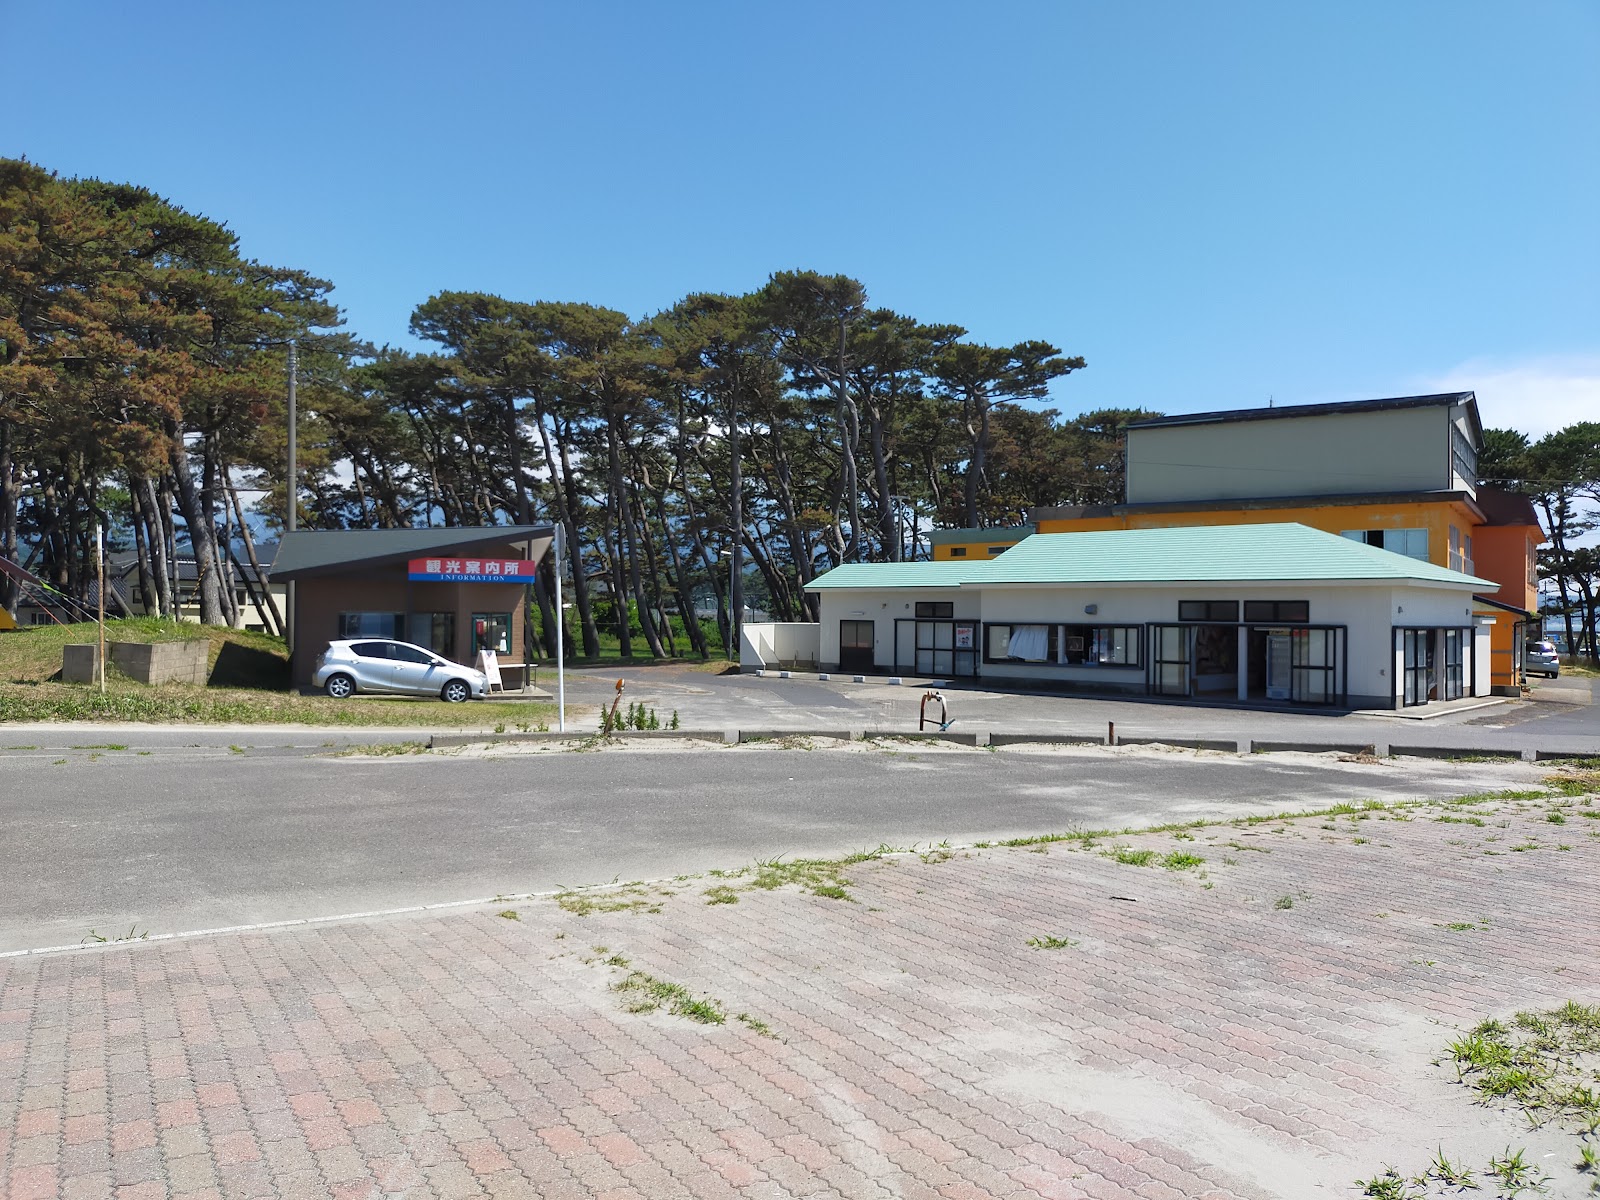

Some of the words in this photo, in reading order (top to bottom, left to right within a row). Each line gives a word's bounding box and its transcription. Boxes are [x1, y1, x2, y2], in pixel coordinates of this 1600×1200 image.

[426, 560, 519, 575] 観光案内所
